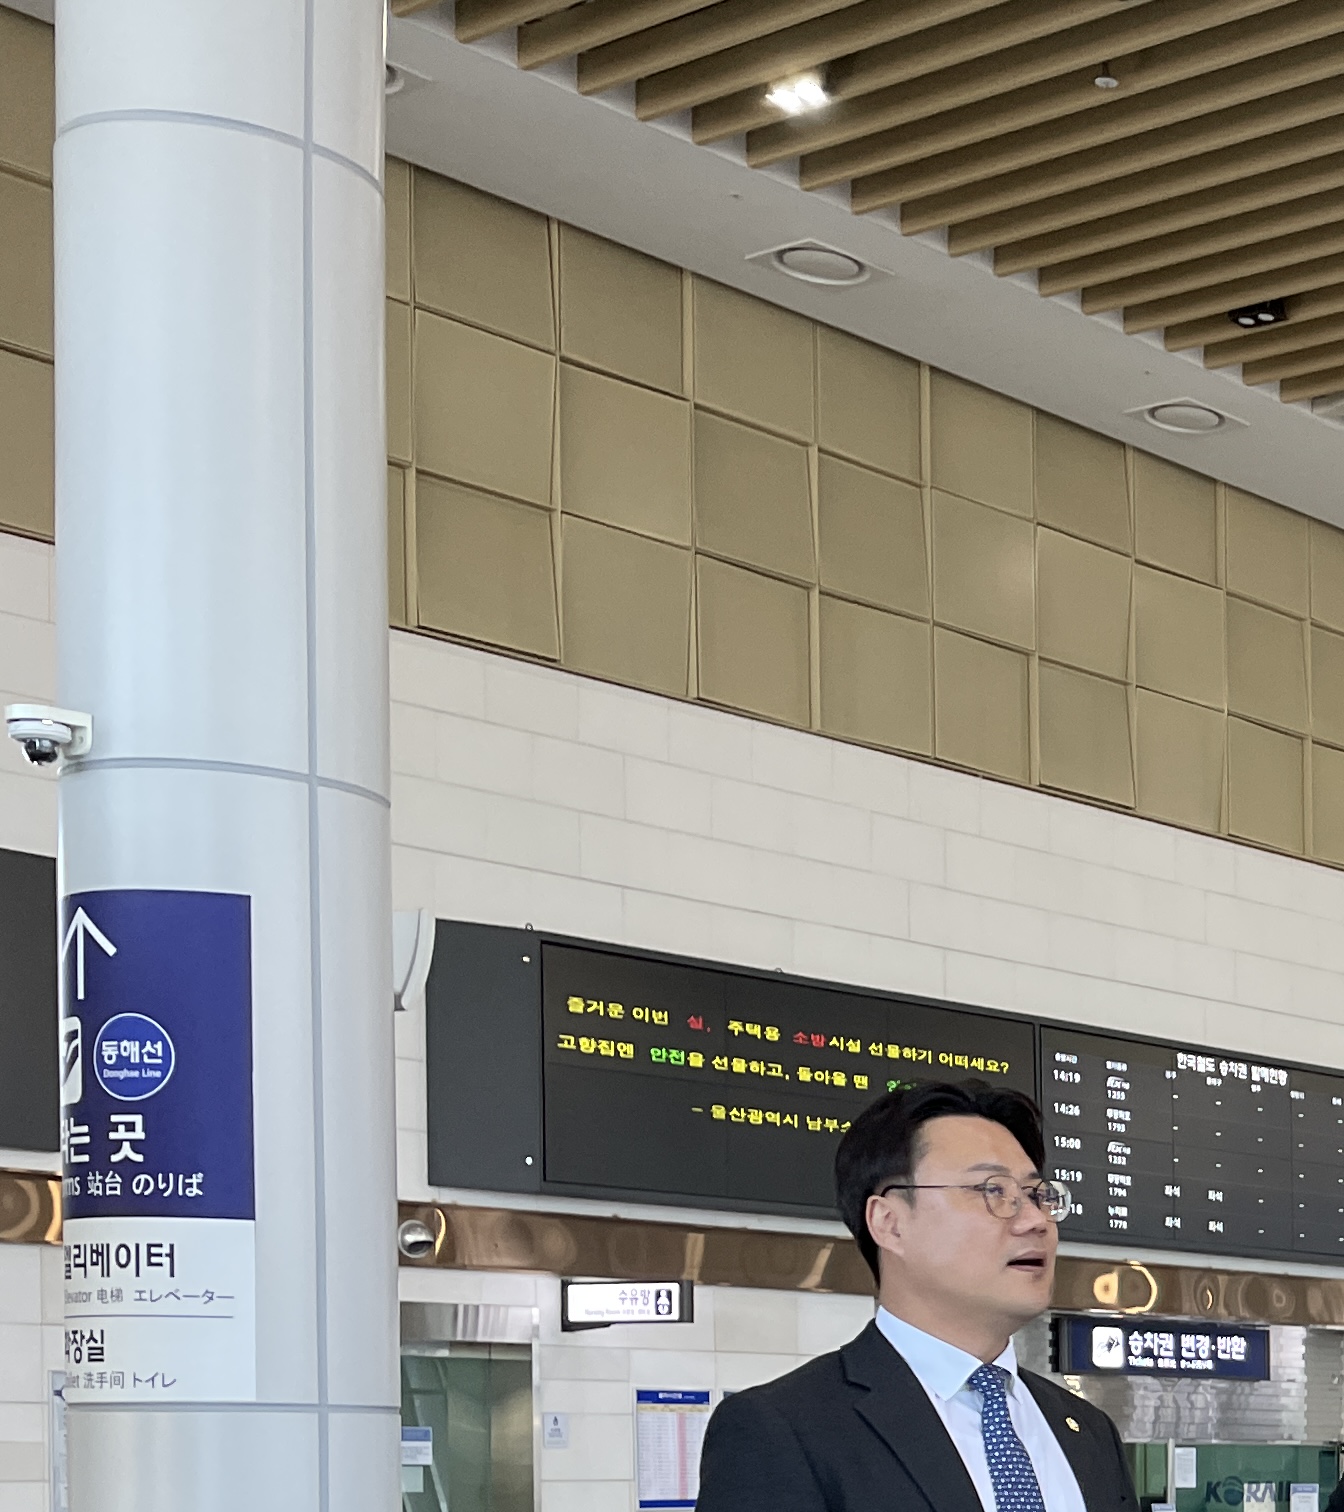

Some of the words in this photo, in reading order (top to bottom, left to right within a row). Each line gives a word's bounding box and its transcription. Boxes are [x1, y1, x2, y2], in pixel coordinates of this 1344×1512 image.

[567, 996, 625, 1020] 즐거운
[632, 1007, 669, 1026] 이번
[727, 1019, 781, 1042] 주택용
[868, 1042, 933, 1065] 선물하기
[938, 1052, 1010, 1074] 어떠세요?
[101, 1040, 163, 1065] 동해선
[557, 1034, 635, 1059] 고향집엔
[650, 1047, 706, 1068] 안전을
[711, 1055, 790, 1080] 선물하고,
[797, 1066, 848, 1087] 돌아올
[103, 1068, 140, 1080] Donghae
[141, 1068, 162, 1079] Line
[1053, 1069, 1081, 1083] 14:19
[1219, 1060, 1248, 1079] 승차권
[710, 1104, 799, 1129] 울산광역시
[1053, 1102, 1081, 1116] 14:26
[108, 1114, 146, 1163] 곳
[1054, 1136, 1081, 1150] 15:00
[87, 1170, 122, 1197] 站台
[132, 1171, 204, 1198] のりば
[1054, 1169, 1083, 1182] 15:19
[97, 1287, 124, 1304] 电梯
[133, 1288, 235, 1305] エレベーター
[619, 1289, 650, 1306] 수유방
[1128, 1331, 1174, 1357] 승차권
[83, 1371, 125, 1389] 洗手间
[132, 1372, 177, 1389] トイレ
